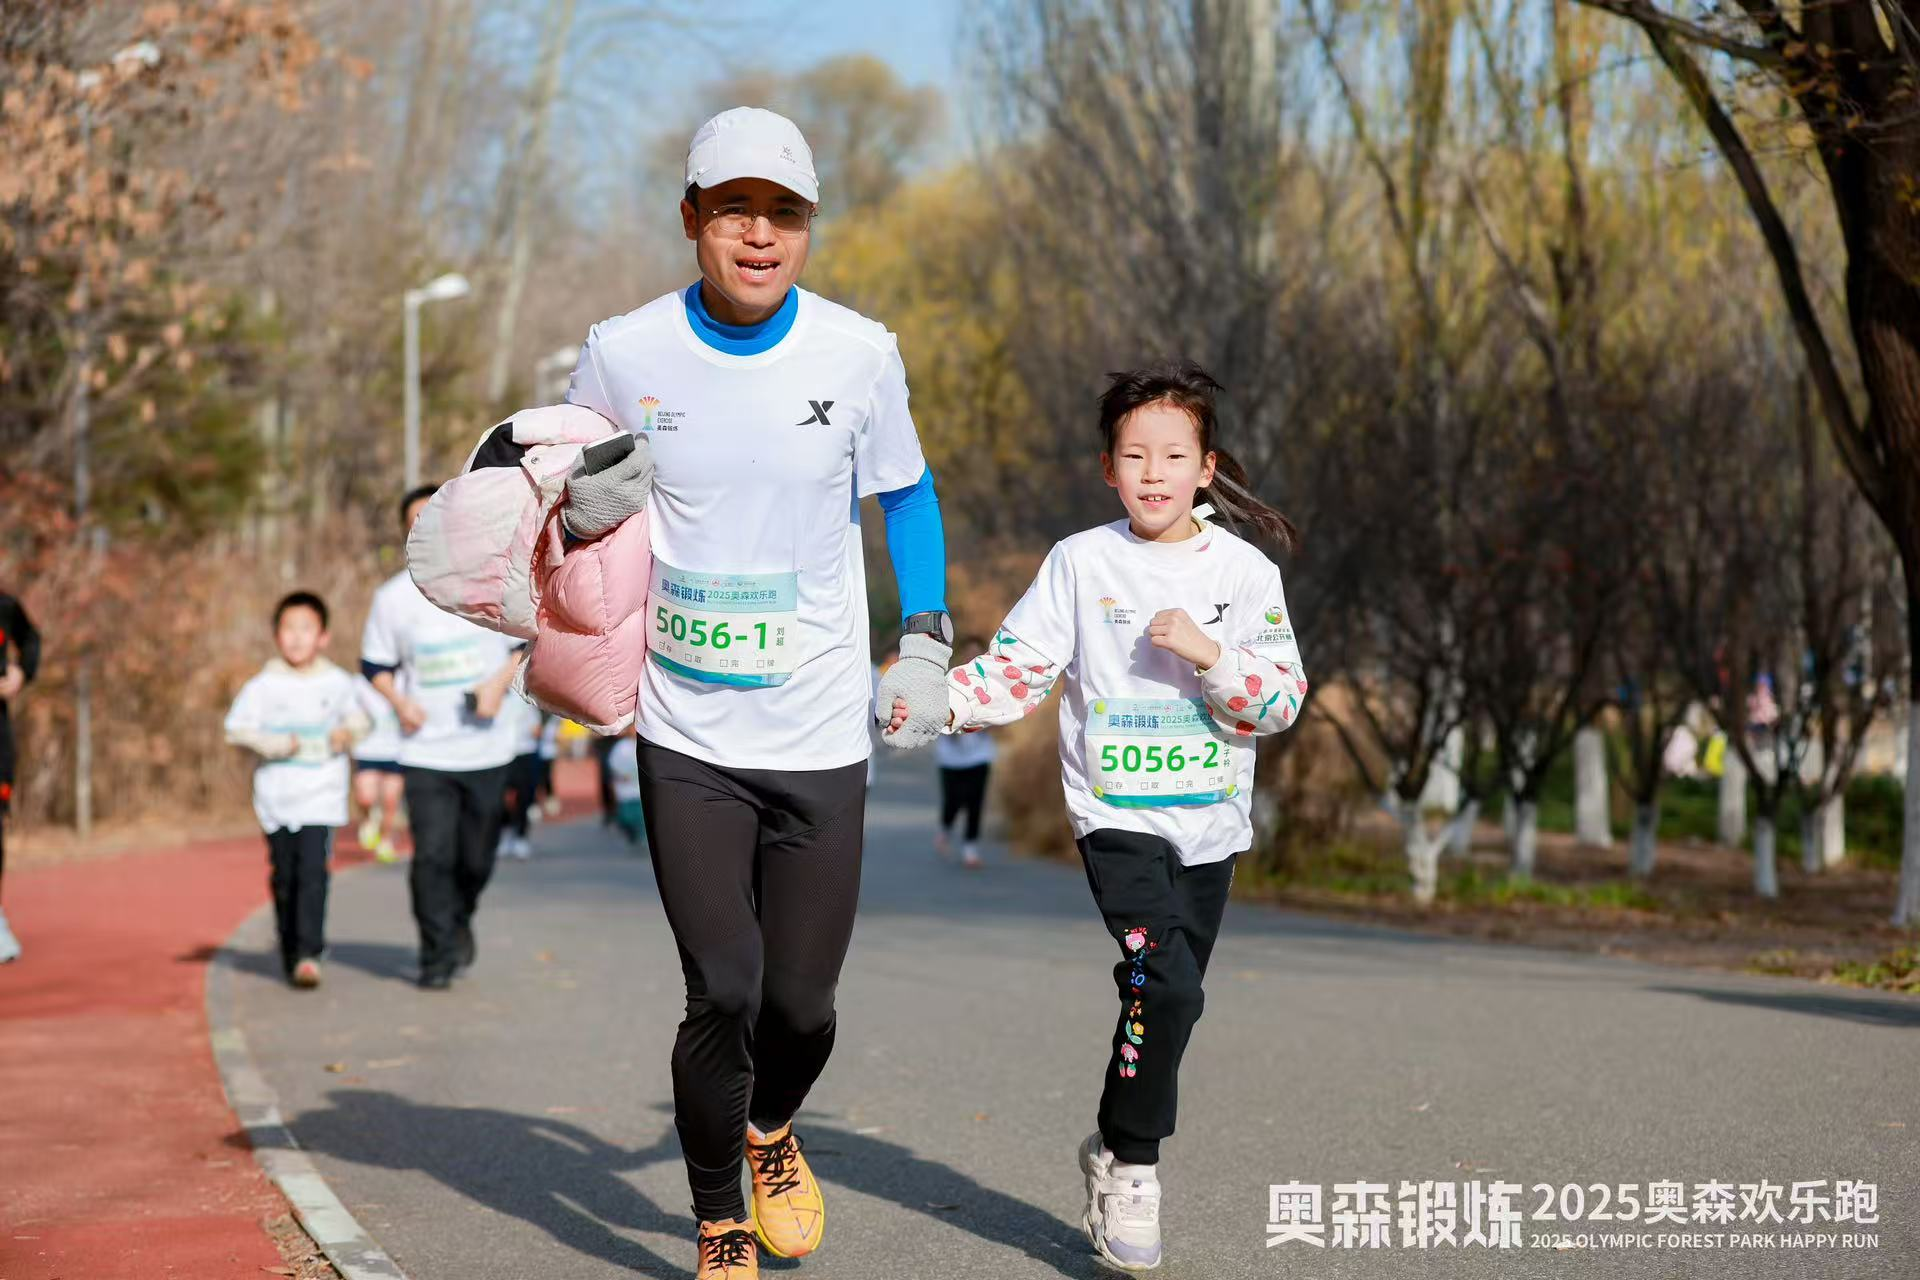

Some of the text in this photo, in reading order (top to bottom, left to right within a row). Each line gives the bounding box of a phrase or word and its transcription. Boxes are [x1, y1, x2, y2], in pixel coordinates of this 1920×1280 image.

[661, 578, 706, 603] 奥森锻炼
[707, 590, 777, 601] 2025奥森欢乐跑
[656, 605, 767, 650] 5056-1
[1108, 714, 1160, 729] 奥森锻炼
[1101, 741, 1219, 773] 5056-2
